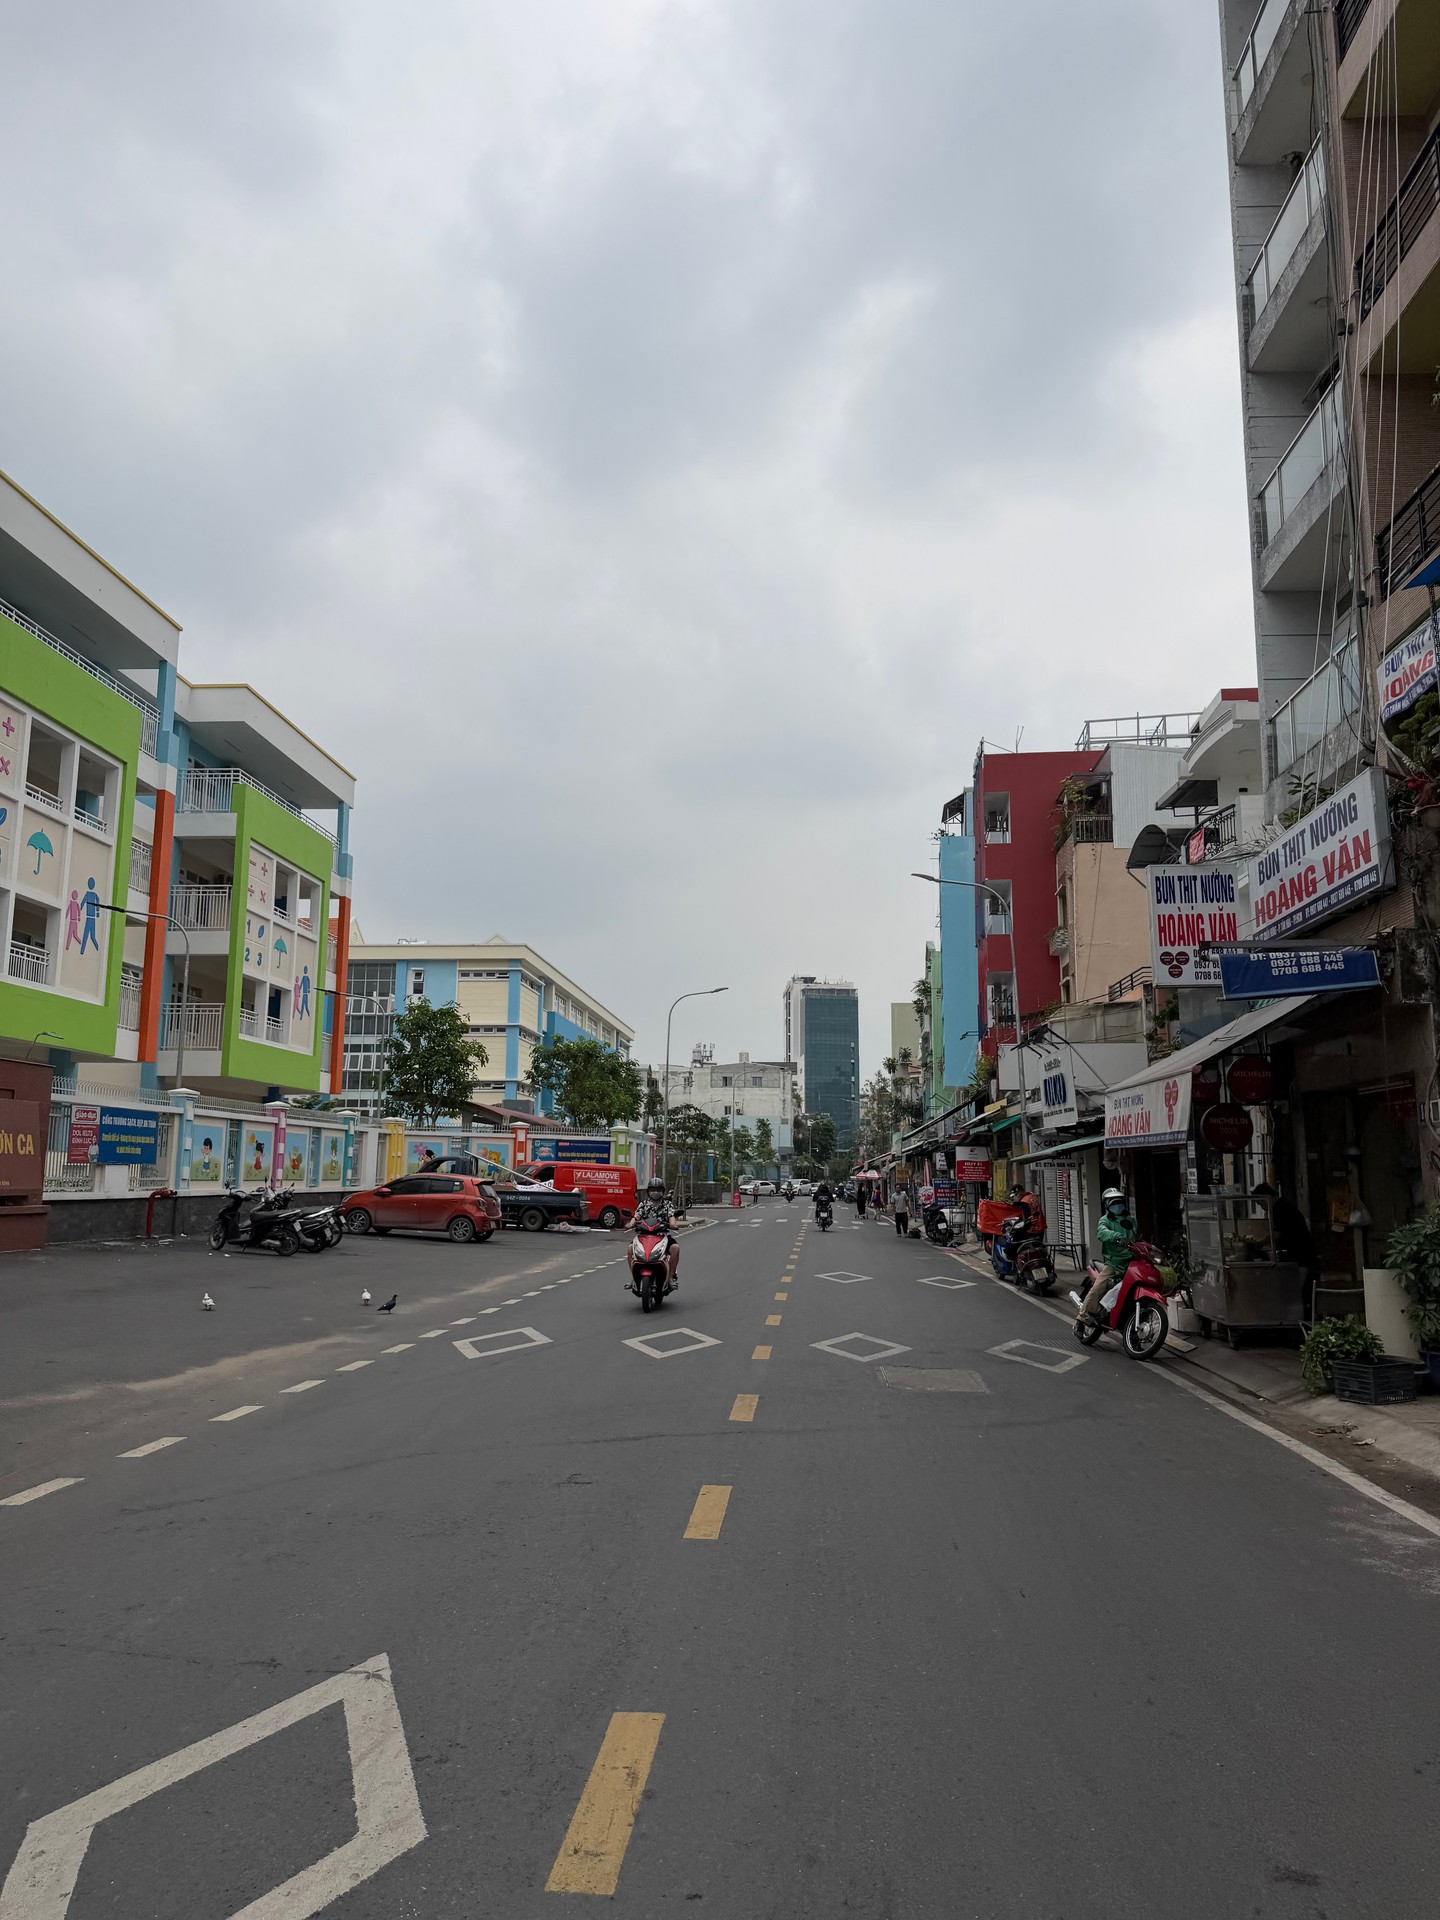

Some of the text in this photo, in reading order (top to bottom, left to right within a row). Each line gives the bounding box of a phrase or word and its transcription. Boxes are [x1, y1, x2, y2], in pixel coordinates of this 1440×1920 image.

[1406, 628, 1428, 660] THỊT
[1257, 792, 1359, 886] BÚN THỊT NƯỚNG
[1155, 868, 1235, 910] BÚN THỊT NƯỚNG
[1254, 828, 1372, 928] HOÀNG VĂN
[1157, 906, 1238, 947] HOÀNG VĂN
[257, 952, 262, 967] 3
[1270, 958, 1296, 968] 0937
[1300, 956, 1320, 964] 688
[1323, 953, 1344, 962] 445
[1271, 961, 1345, 976] 0708 688 445
[1195, 971, 1212, 980] 0708
[1108, 1111, 1133, 1137] HOÀNG
[1209, 1117, 1249, 1125] MICHELIN
[17, 1133, 35, 1155] CA
[582, 1171, 619, 1181] LALAMOVE
